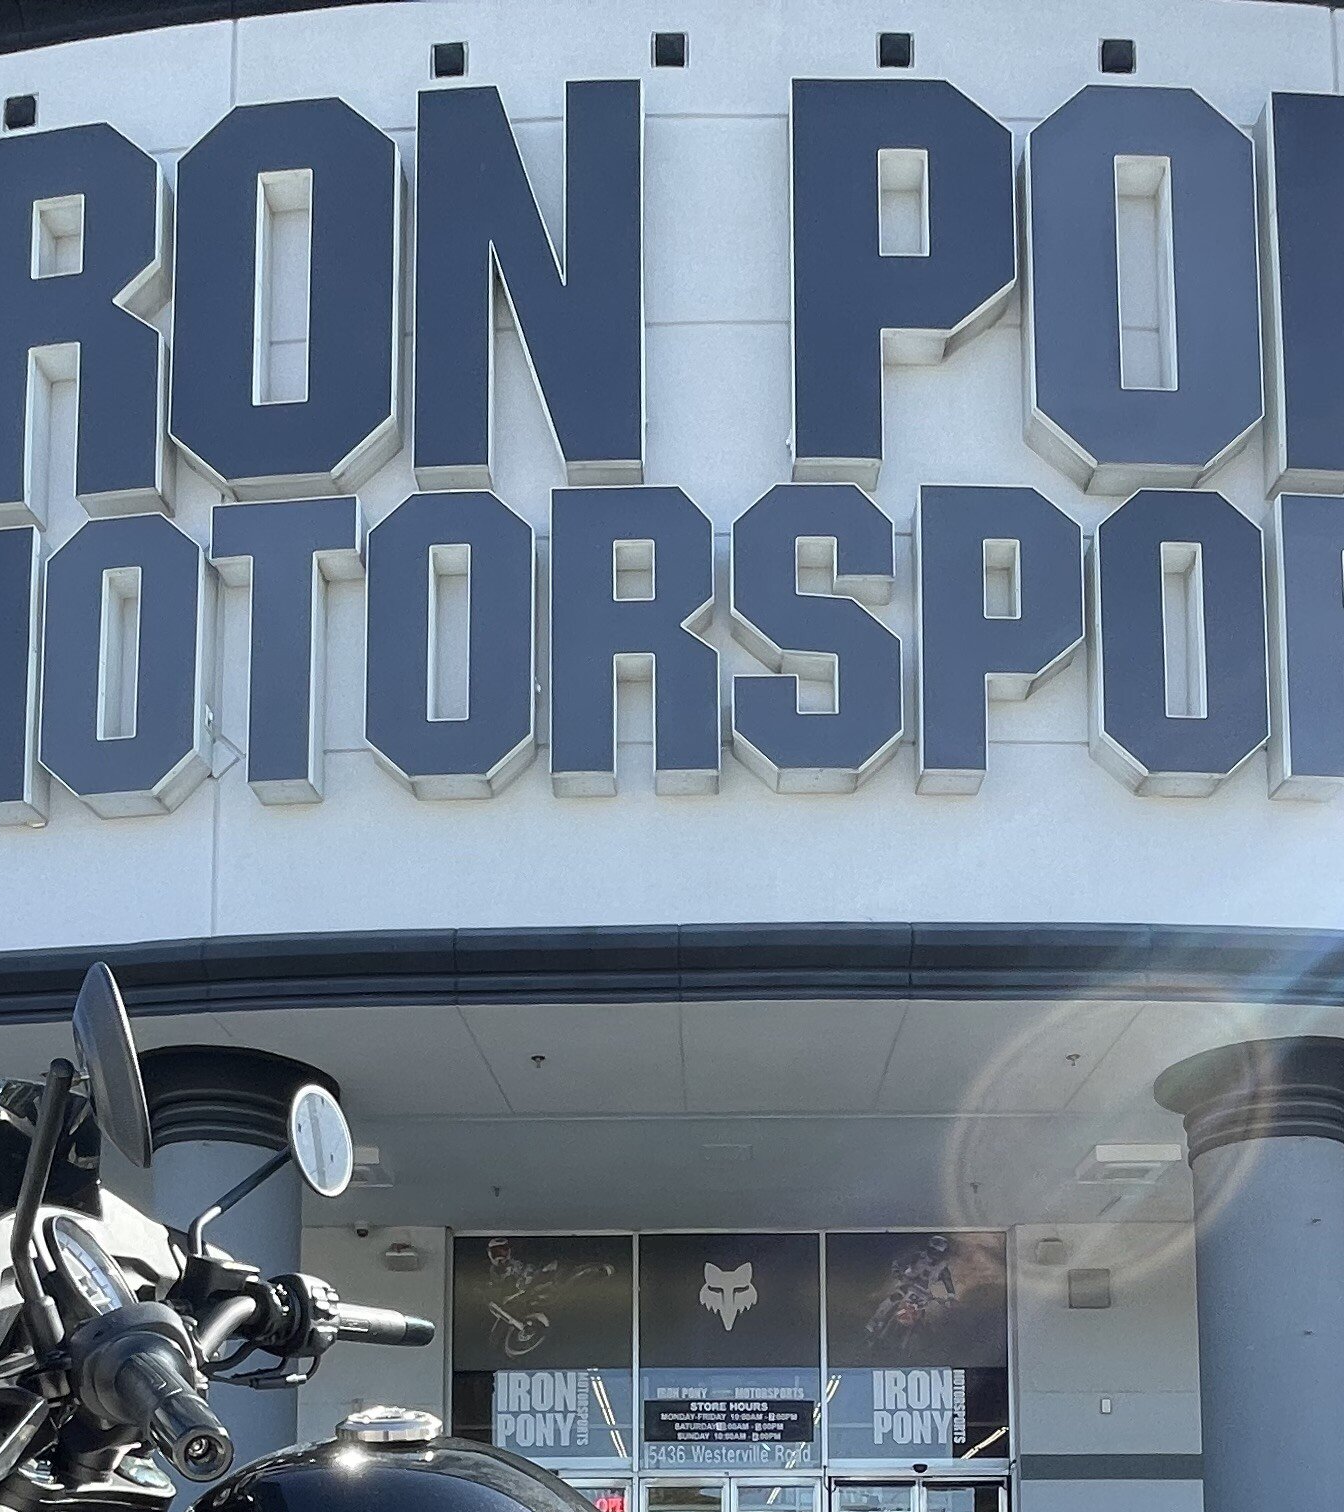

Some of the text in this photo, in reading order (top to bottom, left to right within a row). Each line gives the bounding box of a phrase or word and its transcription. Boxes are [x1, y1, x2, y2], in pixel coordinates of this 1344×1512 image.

[497, 1372, 576, 1411] IRON
[681, 1387, 707, 1399] PONY
[734, 1387, 804, 1399] MOTORSPORTS
[690, 1402, 768, 1411] STORE HOURS
[872, 1369, 953, 1410] IRON
[953, 1369, 966, 1444] MOTORSPORTS
[577, 1371, 589, 1446] MOTORSPORTS
[497, 1413, 576, 1447] PONY
[674, 1422, 716, 1431] SATURDAY
[677, 1432, 709, 1440] SUNDAY
[873, 1410, 953, 1445] PONY
[649, 1445, 686, 1463] 5436
[691, 1445, 769, 1463] Westerville
